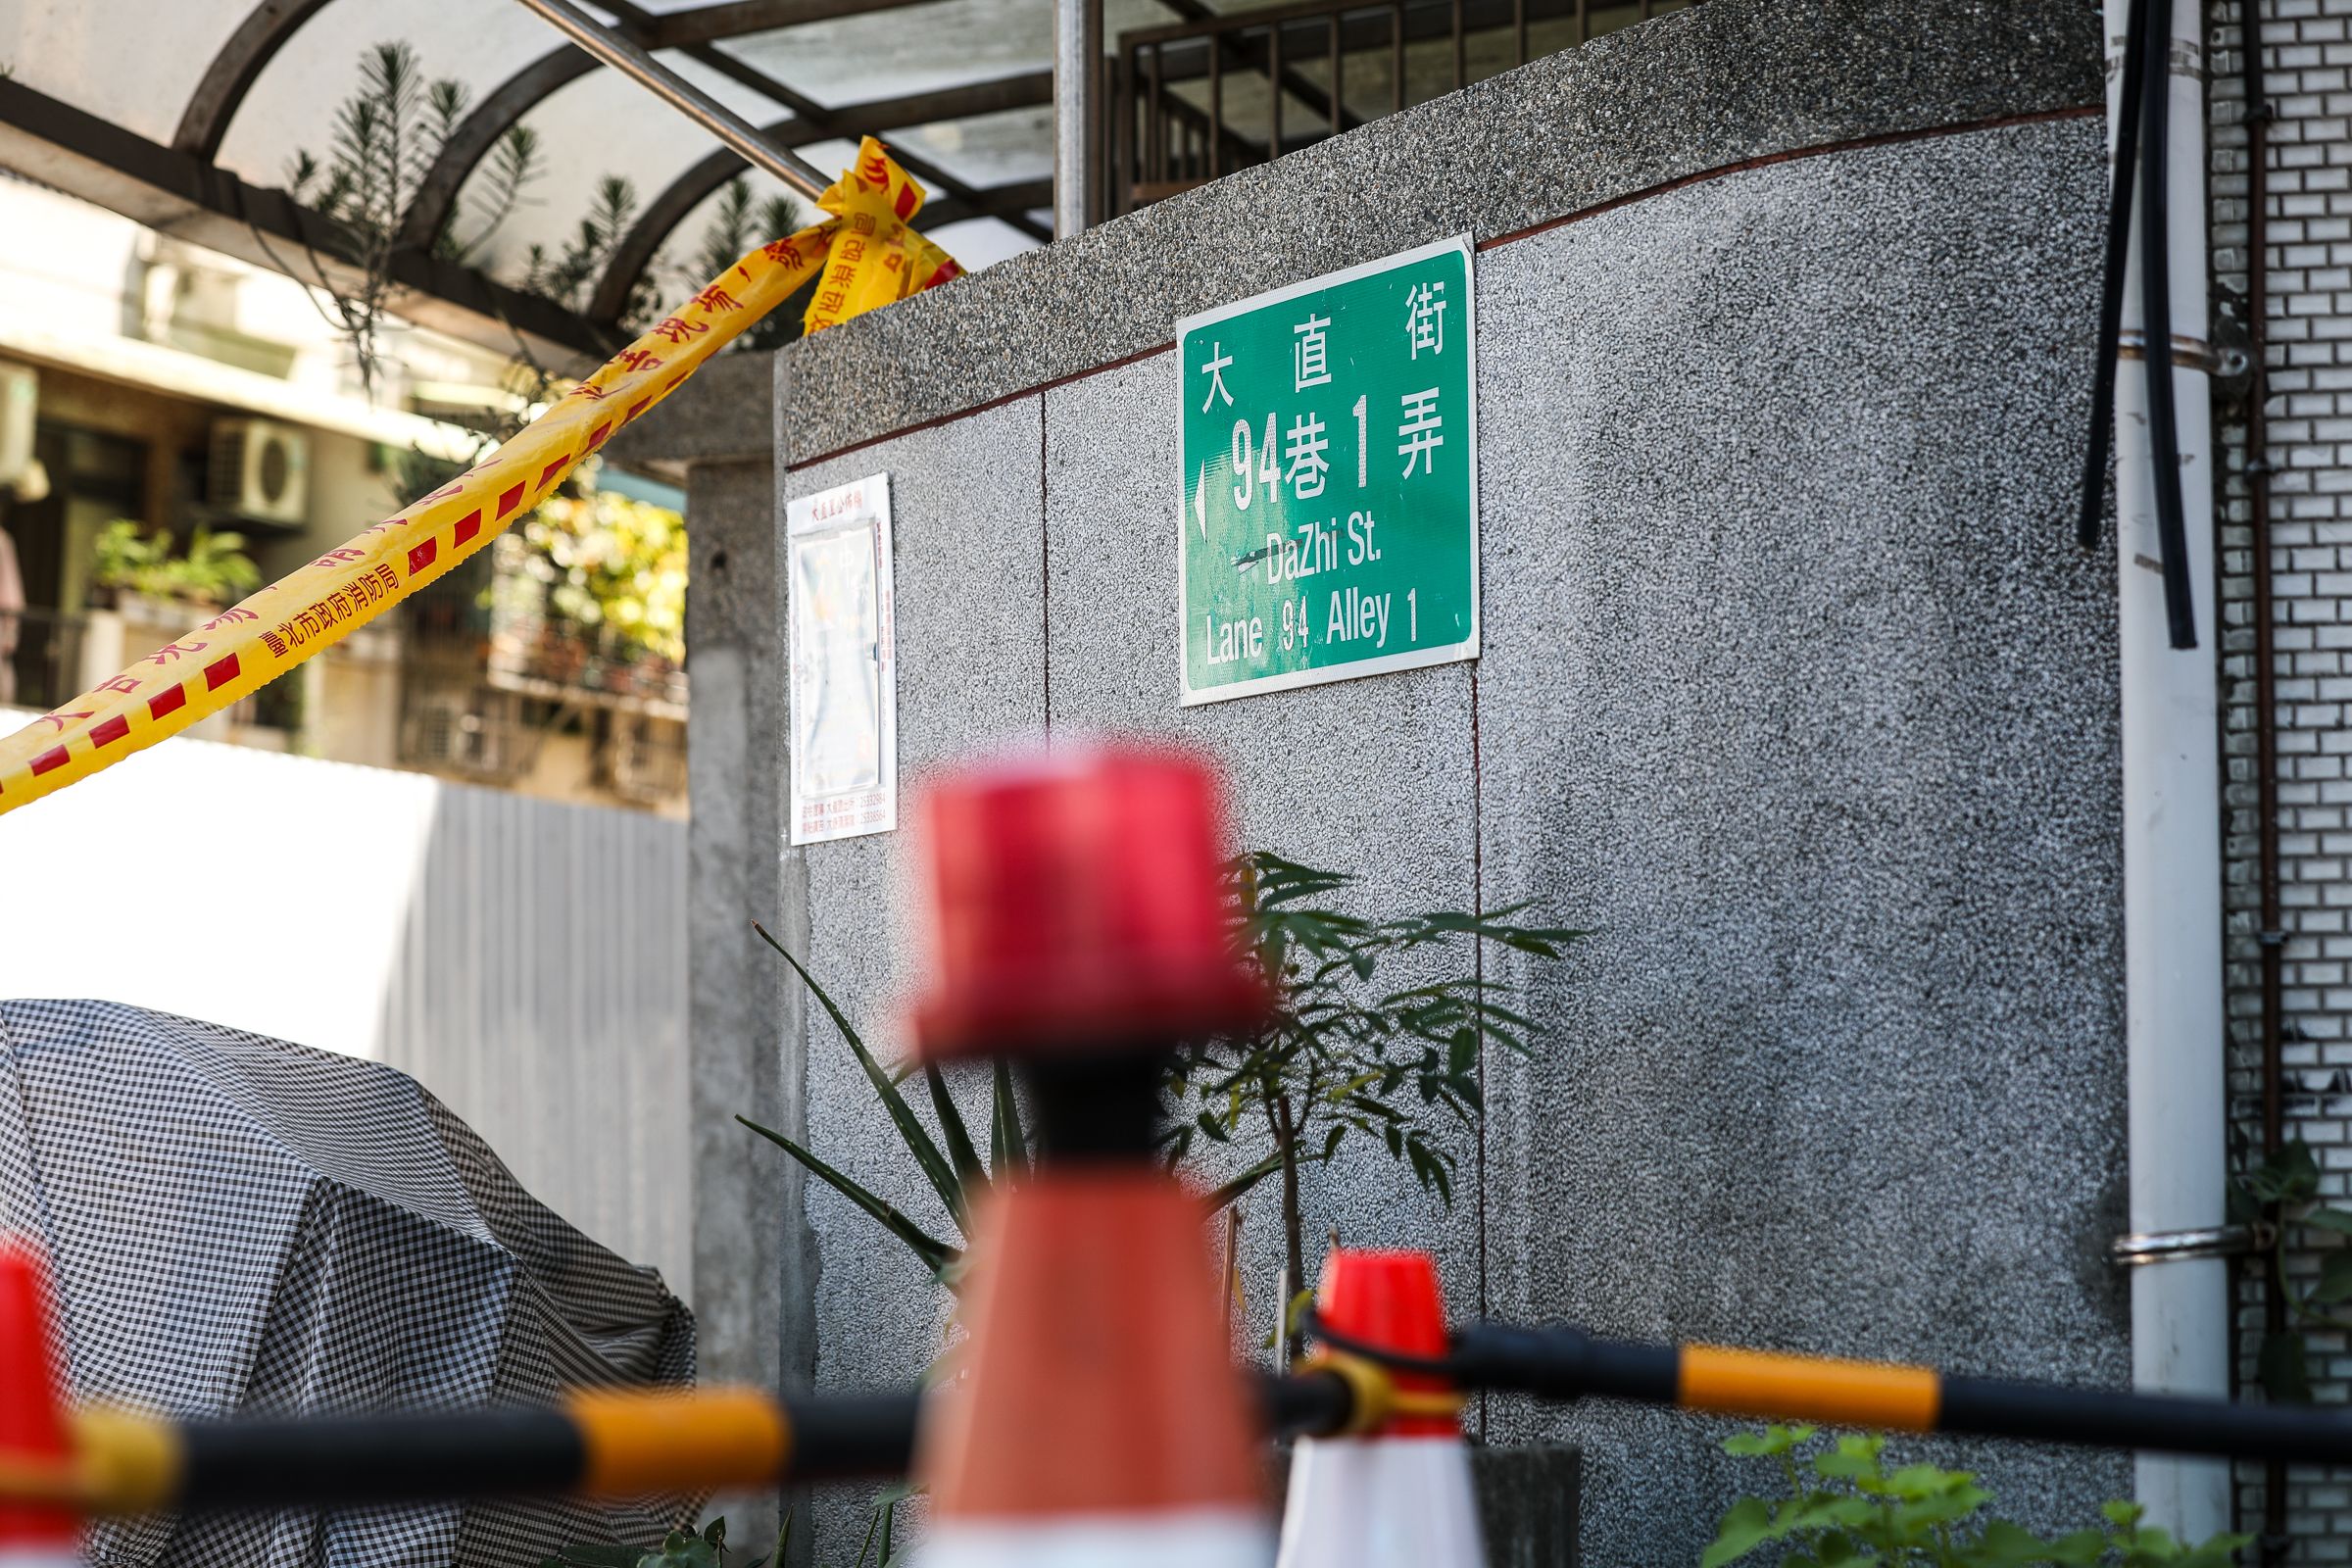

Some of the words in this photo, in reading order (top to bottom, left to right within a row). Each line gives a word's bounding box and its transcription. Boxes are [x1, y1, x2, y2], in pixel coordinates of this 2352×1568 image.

[1201, 279, 1446, 415] 大直街
[1231, 386, 1444, 512] 94巷1弄
[1266, 516, 1339, 586] DaZhi
[1347, 510, 1382, 568] St.
[258, 563, 400, 659] 臺北市政府消防局
[1205, 613, 1264, 666] Lane
[1281, 594, 1309, 651] 94
[1326, 589, 1391, 649] Alley
[1406, 587, 1418, 643] 1
